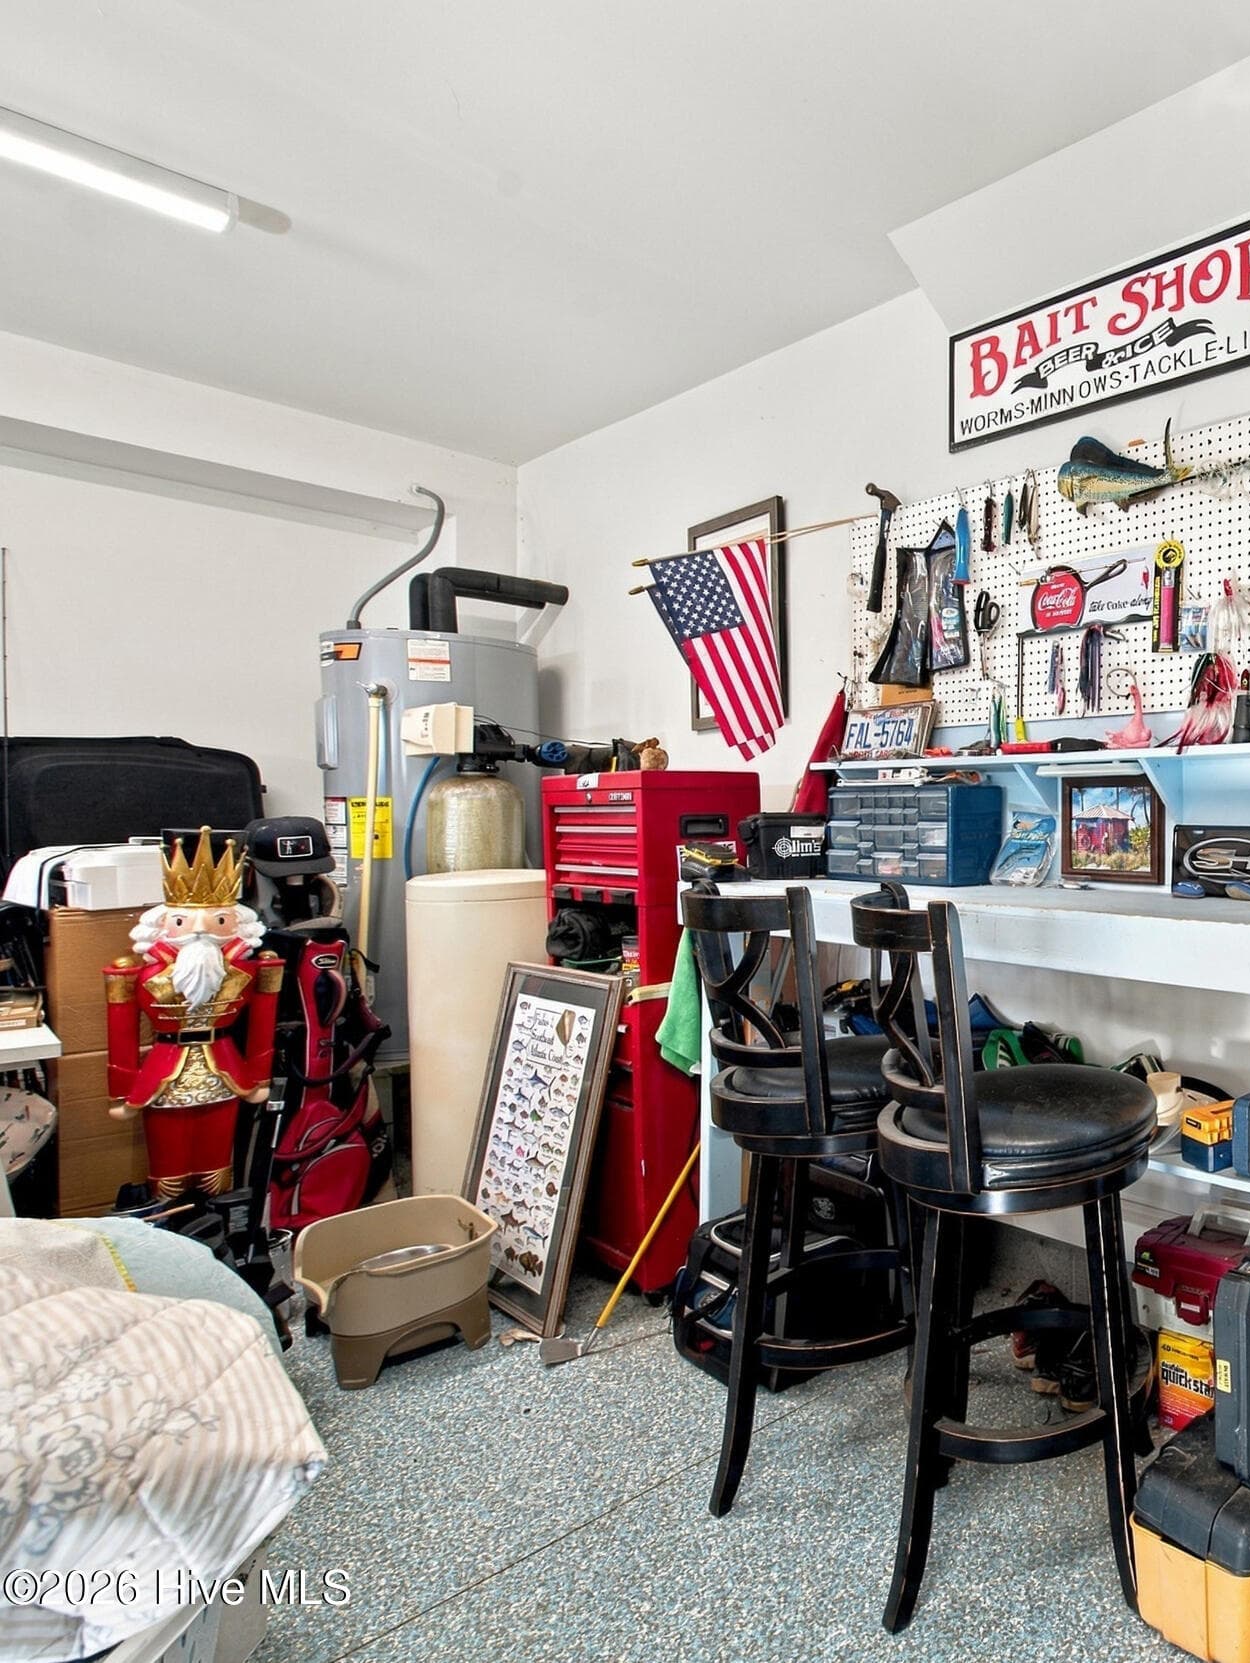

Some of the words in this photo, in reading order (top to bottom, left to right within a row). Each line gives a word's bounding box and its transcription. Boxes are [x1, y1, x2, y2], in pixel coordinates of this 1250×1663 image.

[969, 297, 1098, 398] BAIT
[1038, 342, 1098, 380] BEER
[1122, 321, 1174, 362] ICE
[845, 718, 914, 749] FAL-5764
